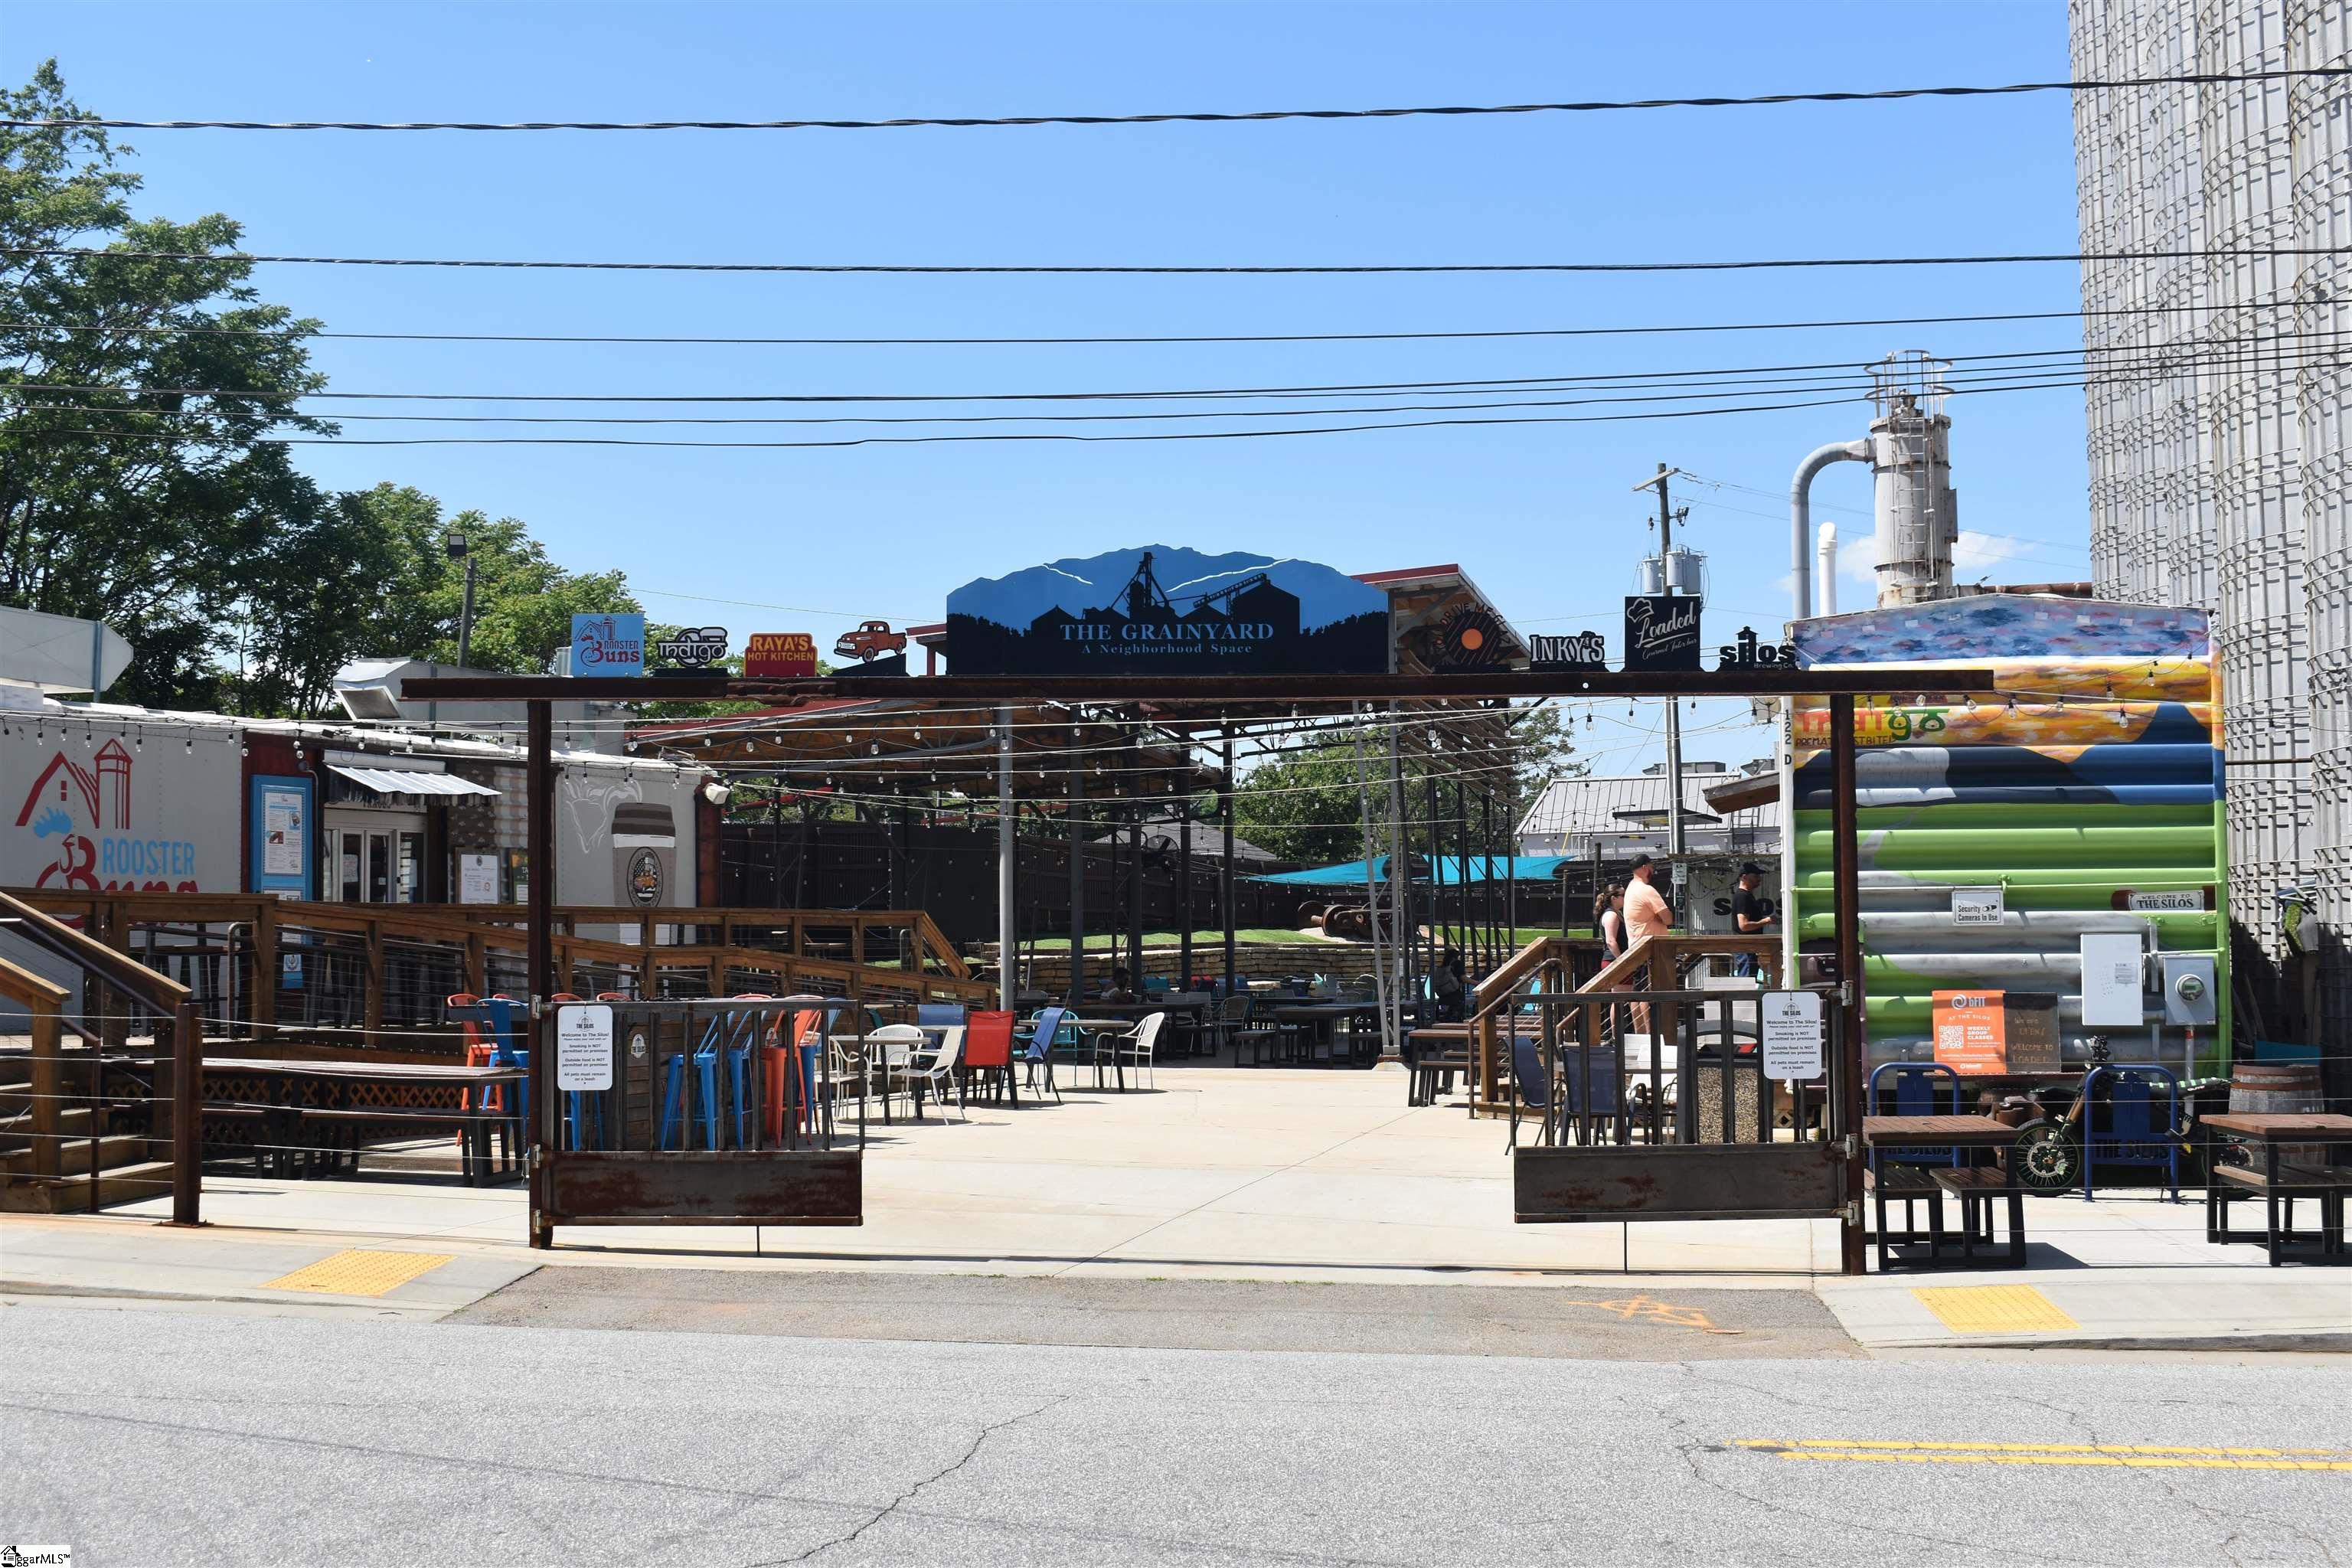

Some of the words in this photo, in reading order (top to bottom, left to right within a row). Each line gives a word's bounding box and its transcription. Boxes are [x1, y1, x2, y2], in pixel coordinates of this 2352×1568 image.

[1060, 624, 1112, 640] THE
[1121, 623, 1275, 640] GRAINYARD
[1634, 601, 1697, 648] Loaded
[604, 640, 639, 650] ROOSTER
[752, 636, 809, 652] RAYA'S
[1082, 644, 1091, 654] A
[1100, 643, 1203, 655] Neighborhood
[1210, 644, 1253, 655] Space
[1530, 636, 1603, 662] INKY'S
[1720, 626, 1796, 663] silos
[581, 641, 640, 668] Buns
[747, 652, 768, 661] HOT
[770, 652, 814, 661] KITCHEN
[1753, 662, 1782, 671] Brewing
[1785, 754, 1792, 765] D
[102, 837, 197, 876] ROOSTER
[1958, 905, 1981, 913] Security
[2136, 900, 2161, 909] THE
[2161, 899, 2194, 908] SILOS
